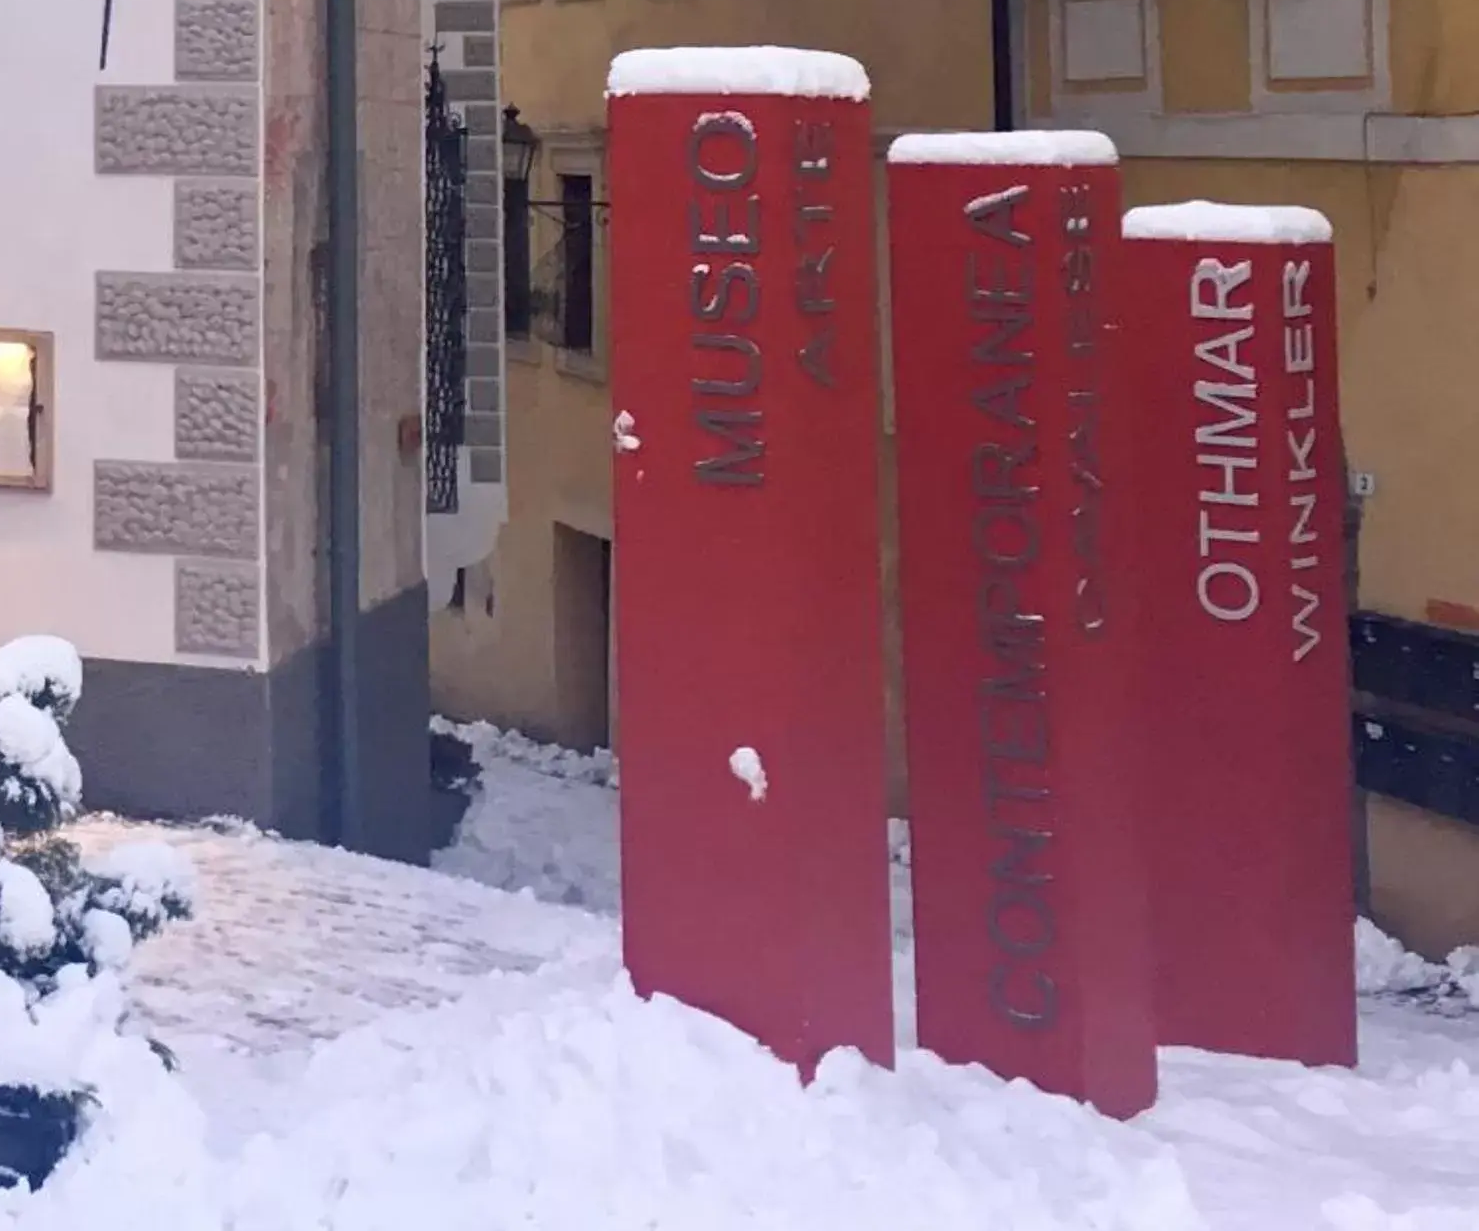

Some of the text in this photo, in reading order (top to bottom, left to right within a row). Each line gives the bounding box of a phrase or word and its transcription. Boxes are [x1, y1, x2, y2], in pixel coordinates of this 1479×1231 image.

[688, 110, 765, 487] MUSEO
[794, 119, 838, 389] ARTE
[1190, 257, 1261, 621] OTHMAR
[965, 184, 1059, 1031] CONTEMPORANEA
[1282, 259, 1321, 663] WINKLER
